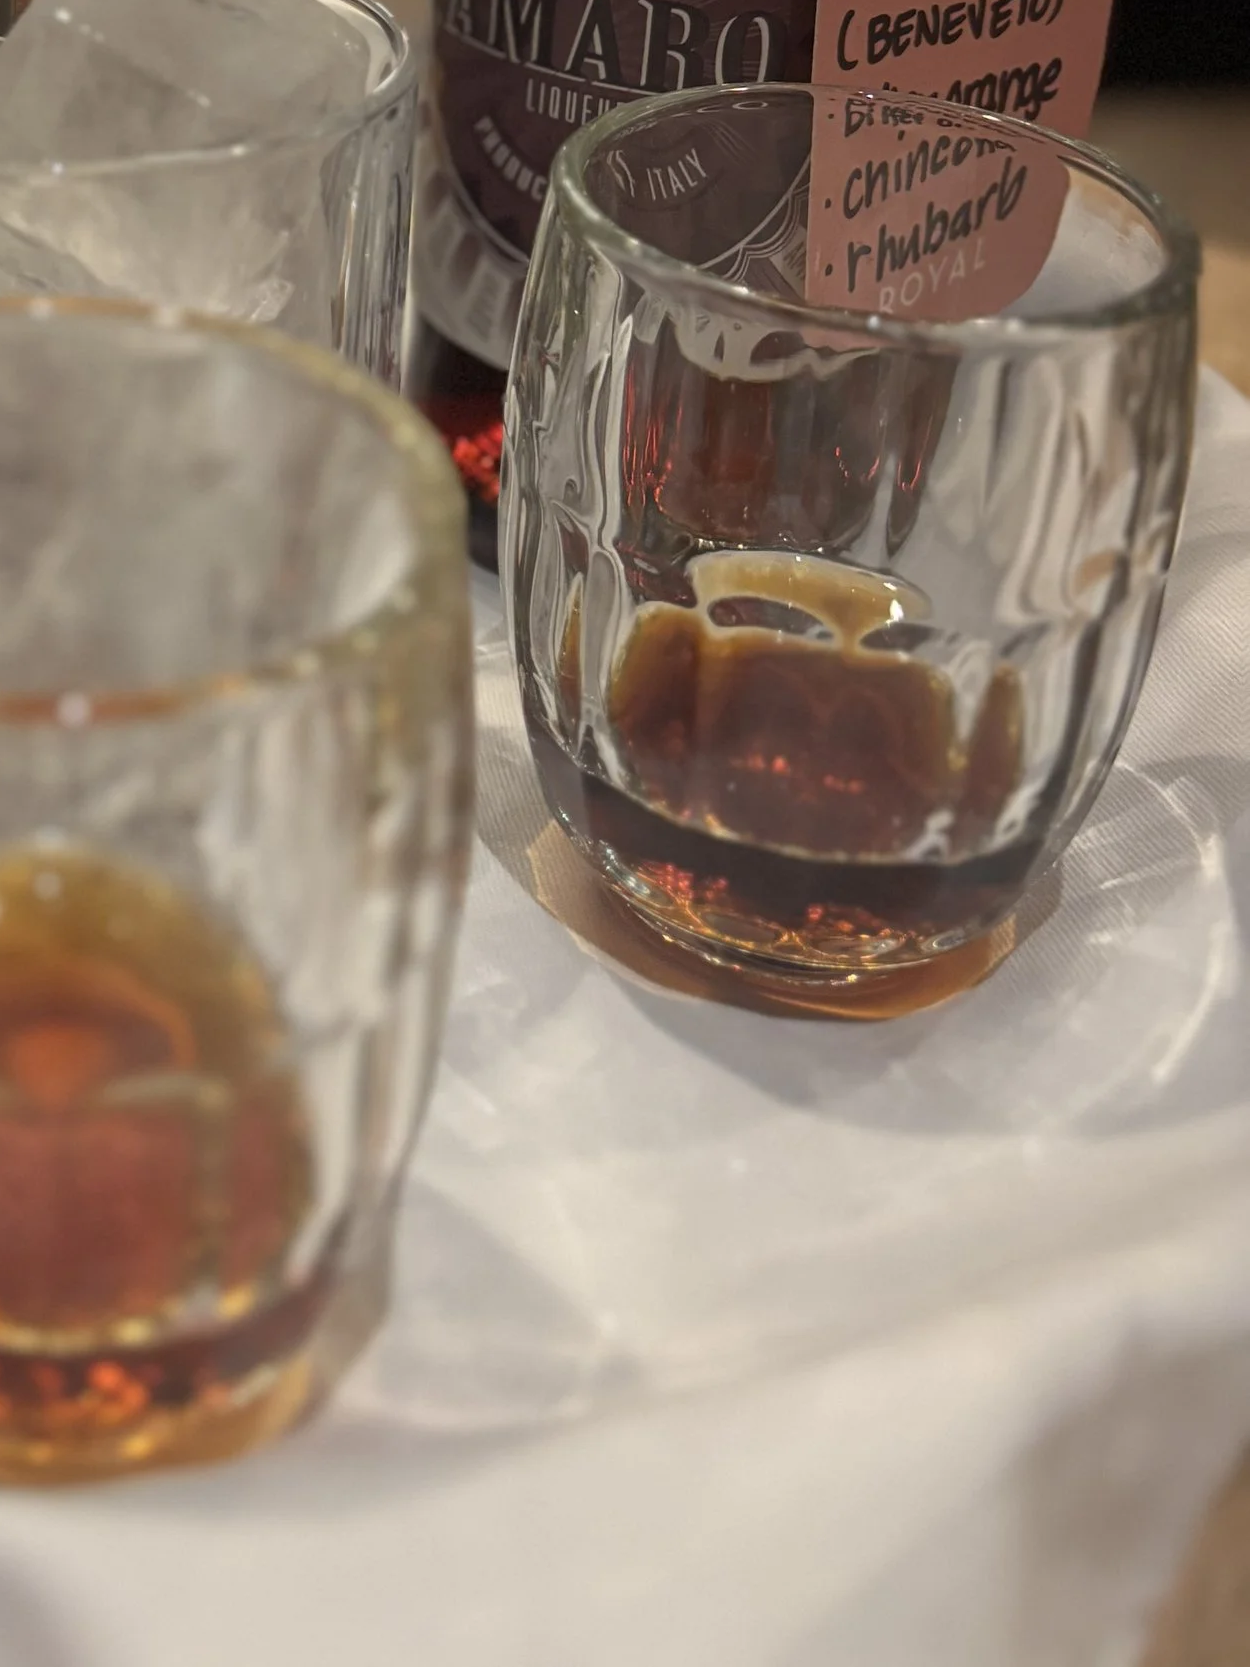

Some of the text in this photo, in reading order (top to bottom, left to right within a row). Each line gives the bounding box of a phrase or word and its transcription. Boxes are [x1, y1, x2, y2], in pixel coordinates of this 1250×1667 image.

[647, 147, 708, 201] ITALY
[847, 156, 1028, 293] rhubarb
[878, 237, 986, 315] ROYAL
